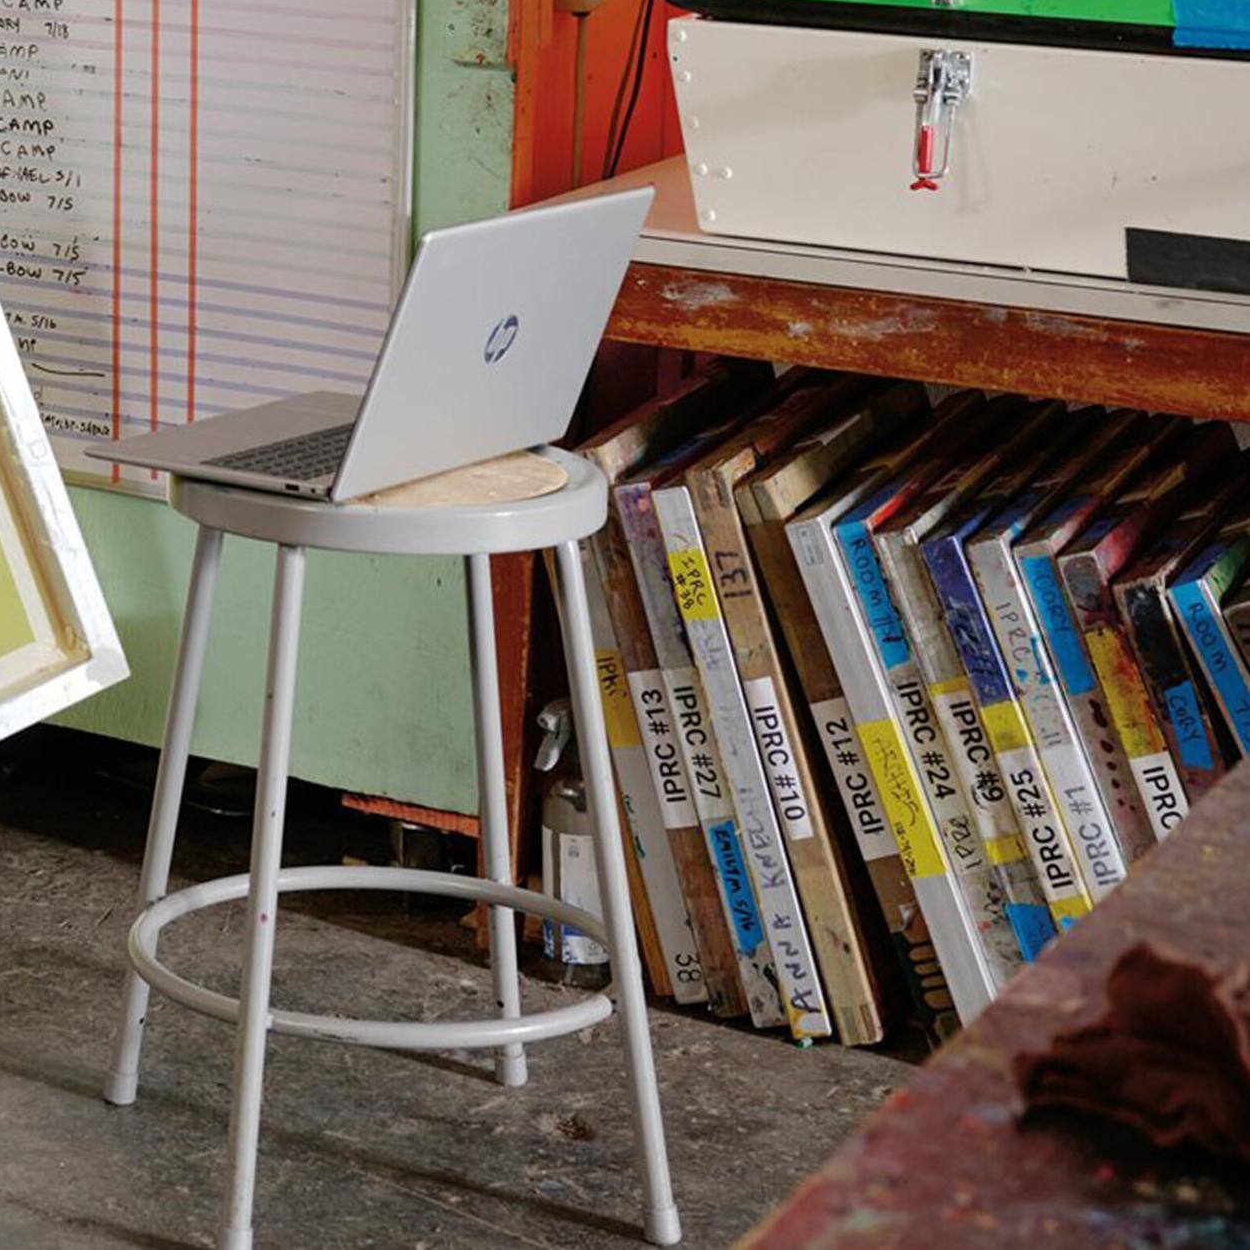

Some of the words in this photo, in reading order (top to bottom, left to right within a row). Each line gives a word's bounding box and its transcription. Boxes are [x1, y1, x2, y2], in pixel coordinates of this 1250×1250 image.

[1, 141, 57, 163] CAMP
[996, 601, 1030, 662] IPRC
[1188, 602, 1228, 672] ROOM
[641, 688, 669, 735] #13
[672, 683, 708, 748] IPRC
[690, 750, 722, 801] #27
[825, 716, 859, 767] #12
[897, 681, 935, 743] IPRC
[918, 748, 953, 800] #24
[950, 700, 991, 765] IPRC
[649, 741, 686, 804] IPRC
[753, 705, 790, 774] IPRC
[773, 774, 804, 822] #10
[1009, 769, 1045, 819] #25
[842, 772, 885, 836] IPRC
[1065, 784, 1092, 822] #1
[1142, 766, 1183, 830] IPRC
[1031, 822, 1073, 889] IPRC
[1078, 826, 1119, 887] IPRC
[674, 951, 702, 985] 38
